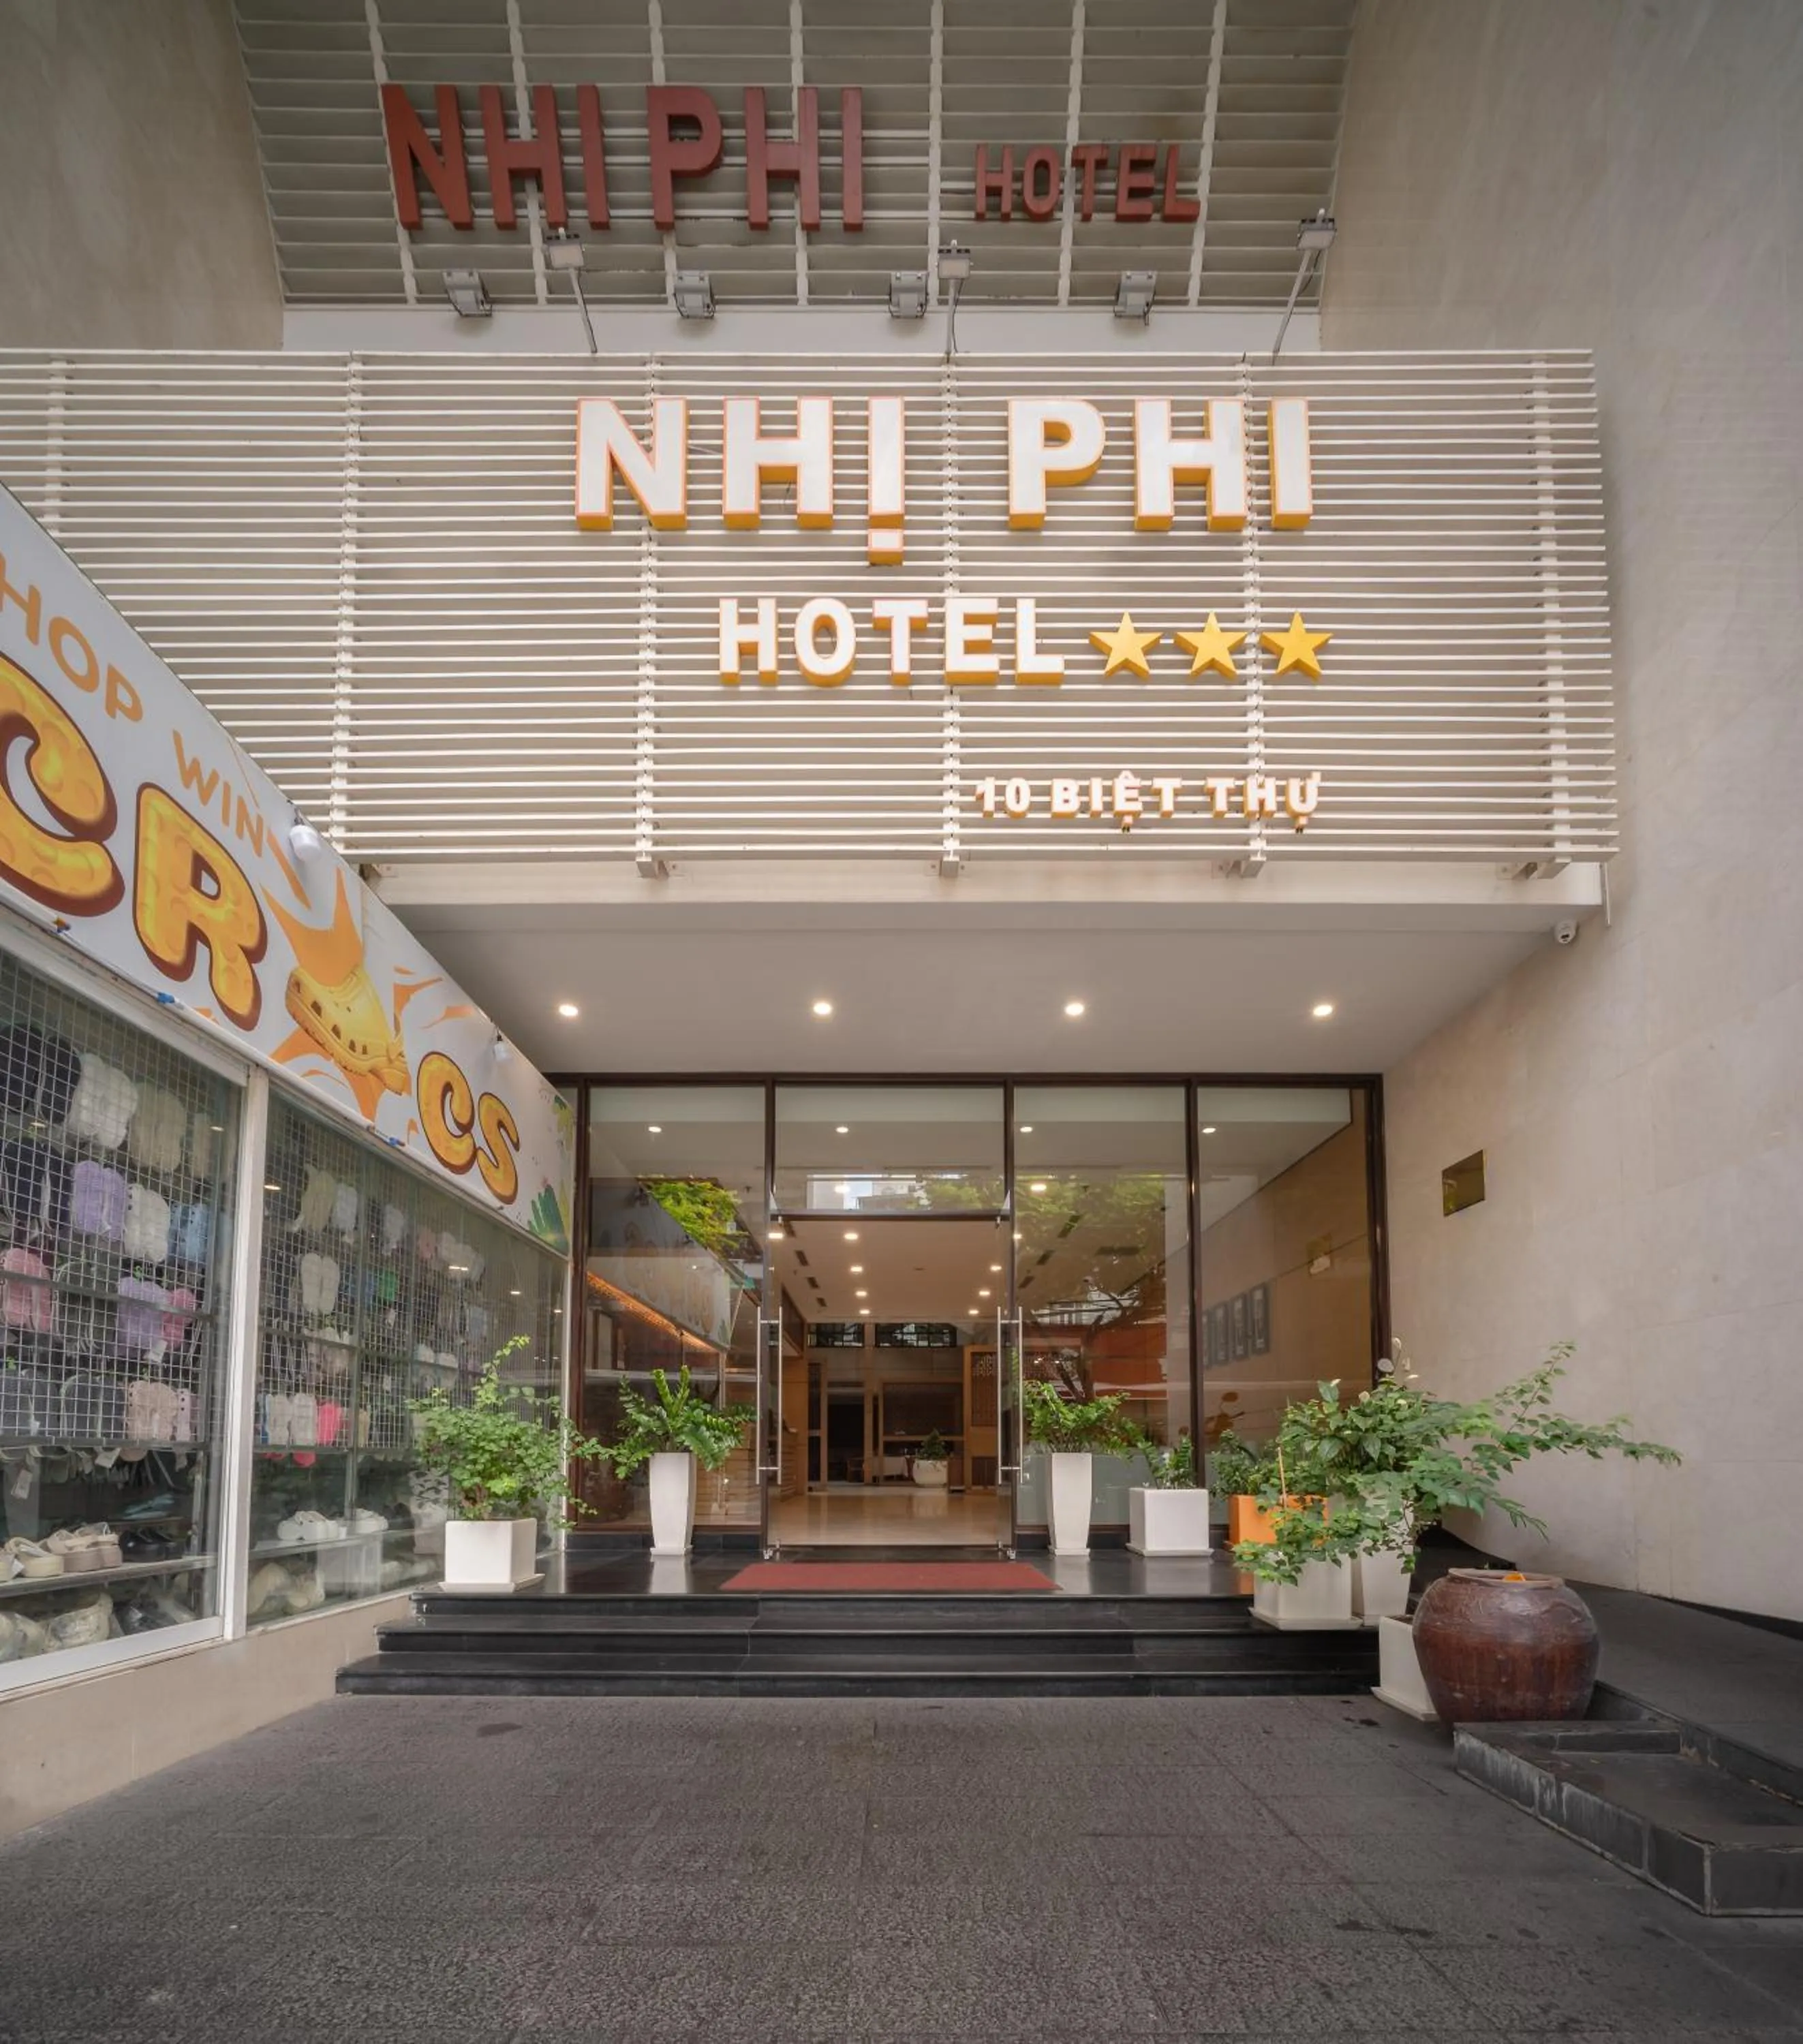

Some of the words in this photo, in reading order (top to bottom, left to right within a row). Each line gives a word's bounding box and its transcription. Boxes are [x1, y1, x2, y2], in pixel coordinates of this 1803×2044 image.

[381, 82, 610, 232] NHI
[646, 85, 863, 232] PHI
[974, 143, 1201, 222] HOTEL
[574, 396, 906, 566] NHỊ
[1006, 397, 1313, 532] PHI
[718, 598, 1066, 687] HOTEL
[172, 729, 264, 858] WIN
[974, 775, 1032, 818] 10
[1049, 768, 1184, 833] BIỆT
[1203, 770, 1322, 834] THỰ
